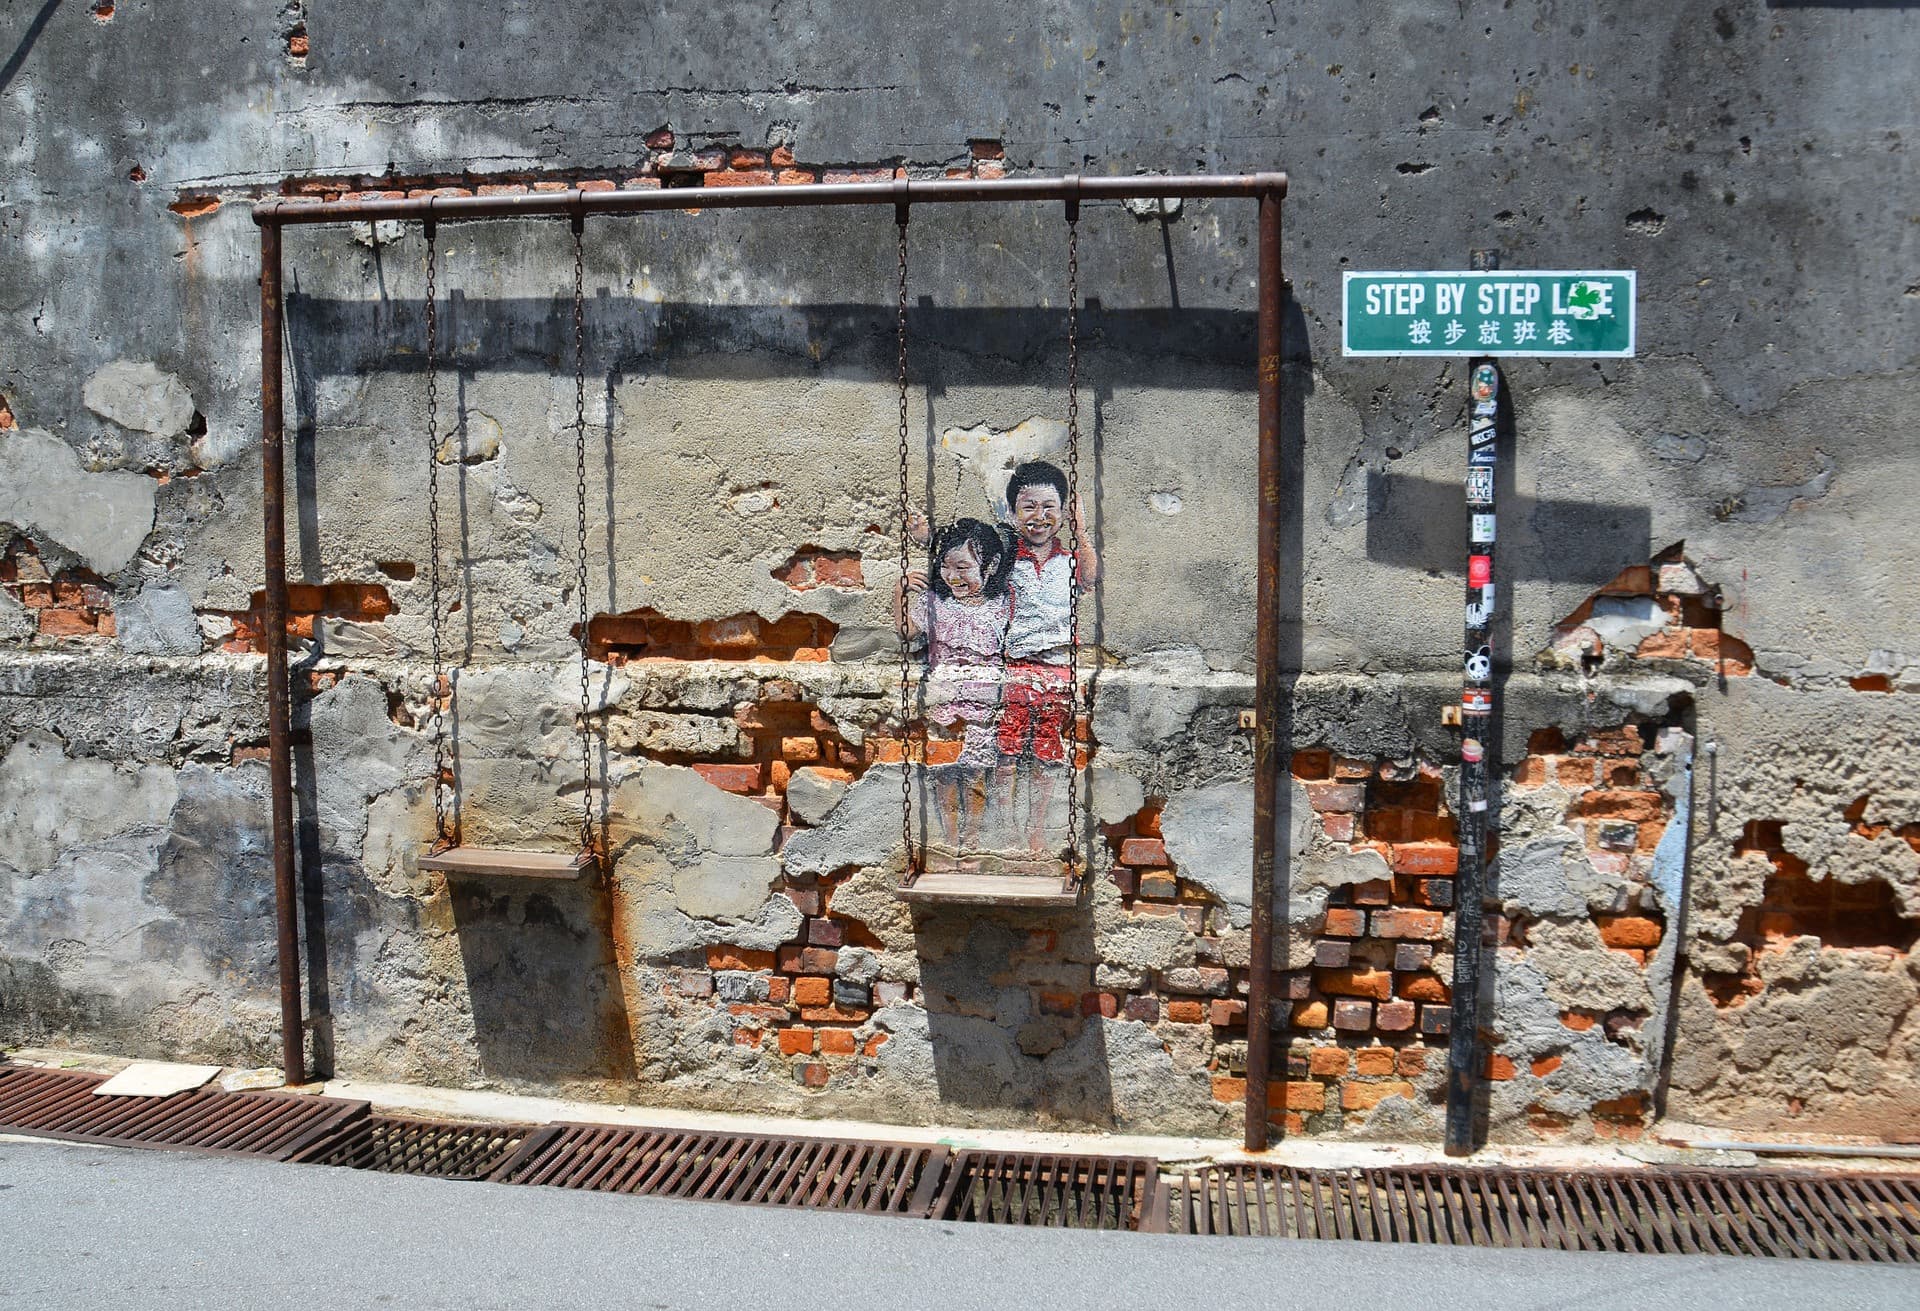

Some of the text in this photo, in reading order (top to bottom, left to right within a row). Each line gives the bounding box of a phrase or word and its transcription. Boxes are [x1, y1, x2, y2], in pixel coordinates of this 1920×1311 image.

[1366, 282, 1614, 315] STEP BY STEP LE
[1408, 318, 1573, 345] 按步就班巷
